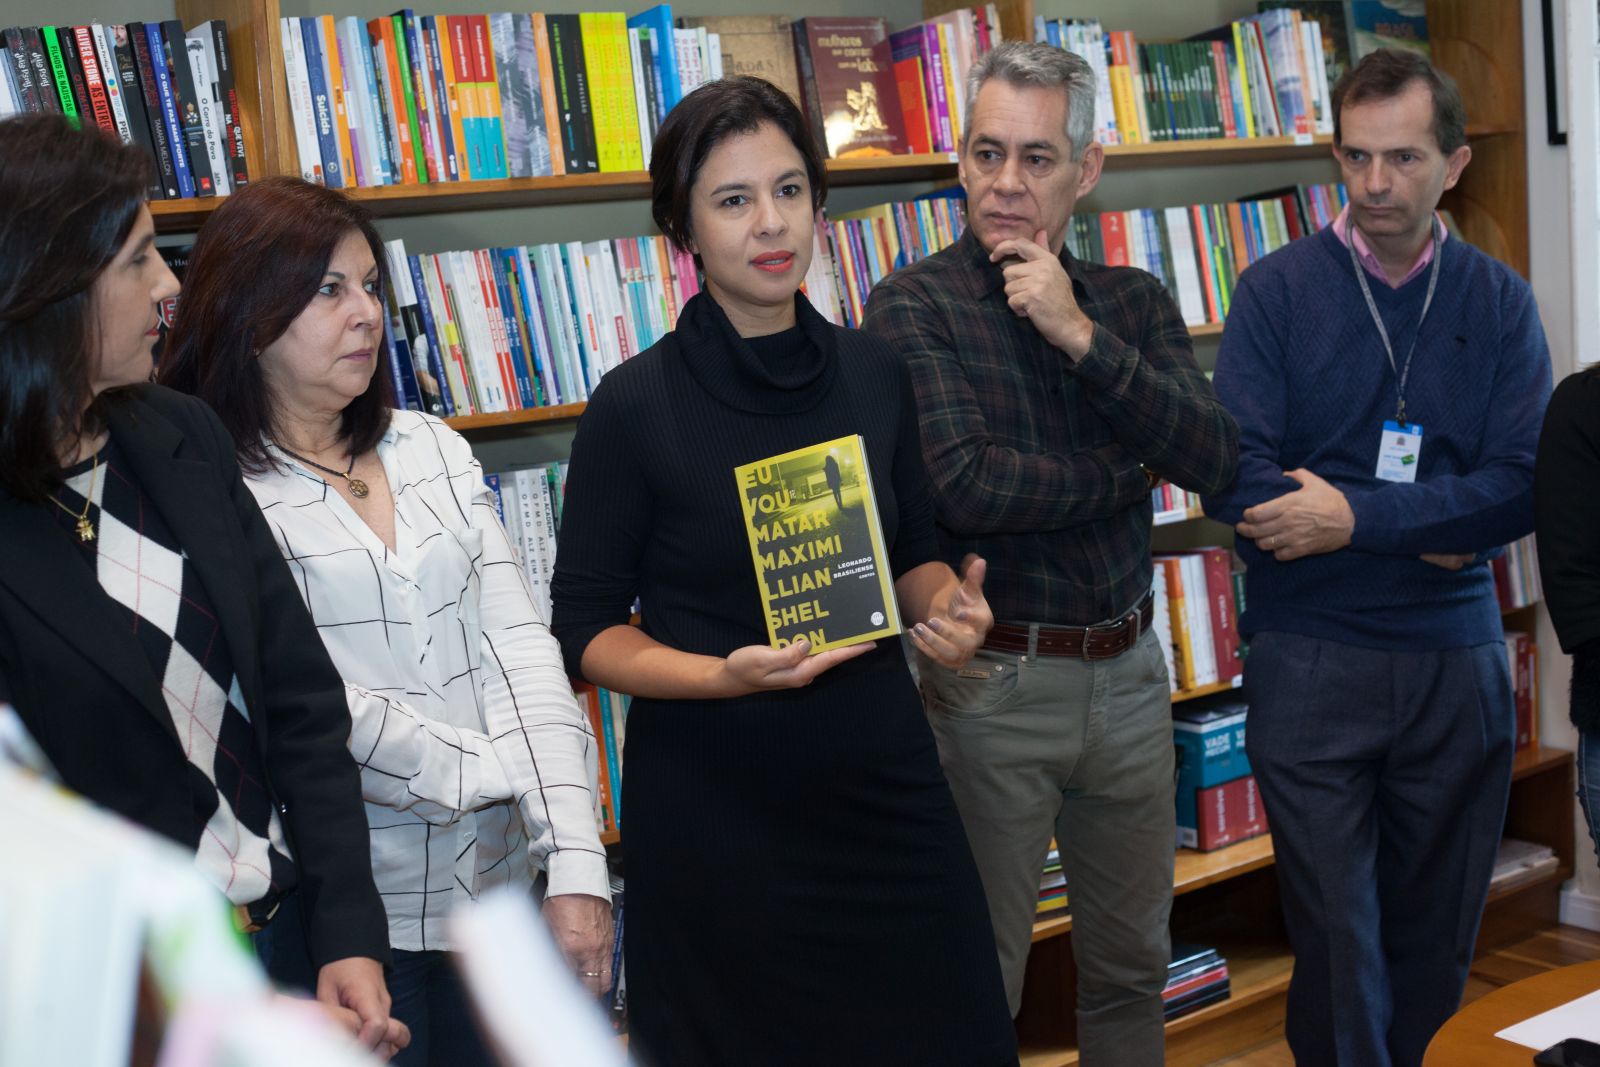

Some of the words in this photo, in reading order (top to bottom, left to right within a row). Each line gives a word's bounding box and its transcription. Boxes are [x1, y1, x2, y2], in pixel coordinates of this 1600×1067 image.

[76, 27, 94, 57] OLIVER
[818, 34, 862, 47] mulheres
[50, 45, 62, 69] FILHOS
[56, 70, 65, 80] DE
[83, 58, 100, 86] STONE
[59, 80, 73, 112] NAZISTAS
[90, 86, 104, 98] AS
[162, 80, 170, 97] QUE
[415, 69, 427, 111] PSICOLOGIA
[576, 73, 588, 114] DEPRESSÃO
[165, 98, 172, 108] TE
[167, 108, 175, 123] FAZ
[202, 106, 212, 127] Carro
[225, 114, 232, 124] NA
[315, 94, 332, 135] Suicida
[170, 123, 180, 143] MAIS
[206, 129, 214, 139] do
[233, 126, 242, 140] QUE
[153, 118, 165, 146] TAMARA
[160, 146, 171, 176] MELLON
[174, 143, 185, 168] FORTE
[208, 141, 218, 160] Povo
[236, 141, 245, 158] VIVI
[539, 475, 549, 496] DIETA
[746, 465, 772, 489] EU
[748, 489, 792, 516] VOU
[543, 503, 553, 539] ACADEMIA
[752, 510, 830, 544] MATAR
[756, 534, 843, 572] MAXIMI
[838, 556, 872, 570] LEONARDO
[833, 564, 874, 579] BRASILIENSE
[859, 572, 875, 580] CONTOS
[767, 567, 832, 600] LLIAN
[770, 600, 830, 630] SHEL
[777, 628, 827, 650] DON
[1204, 732, 1231, 750] VADE
